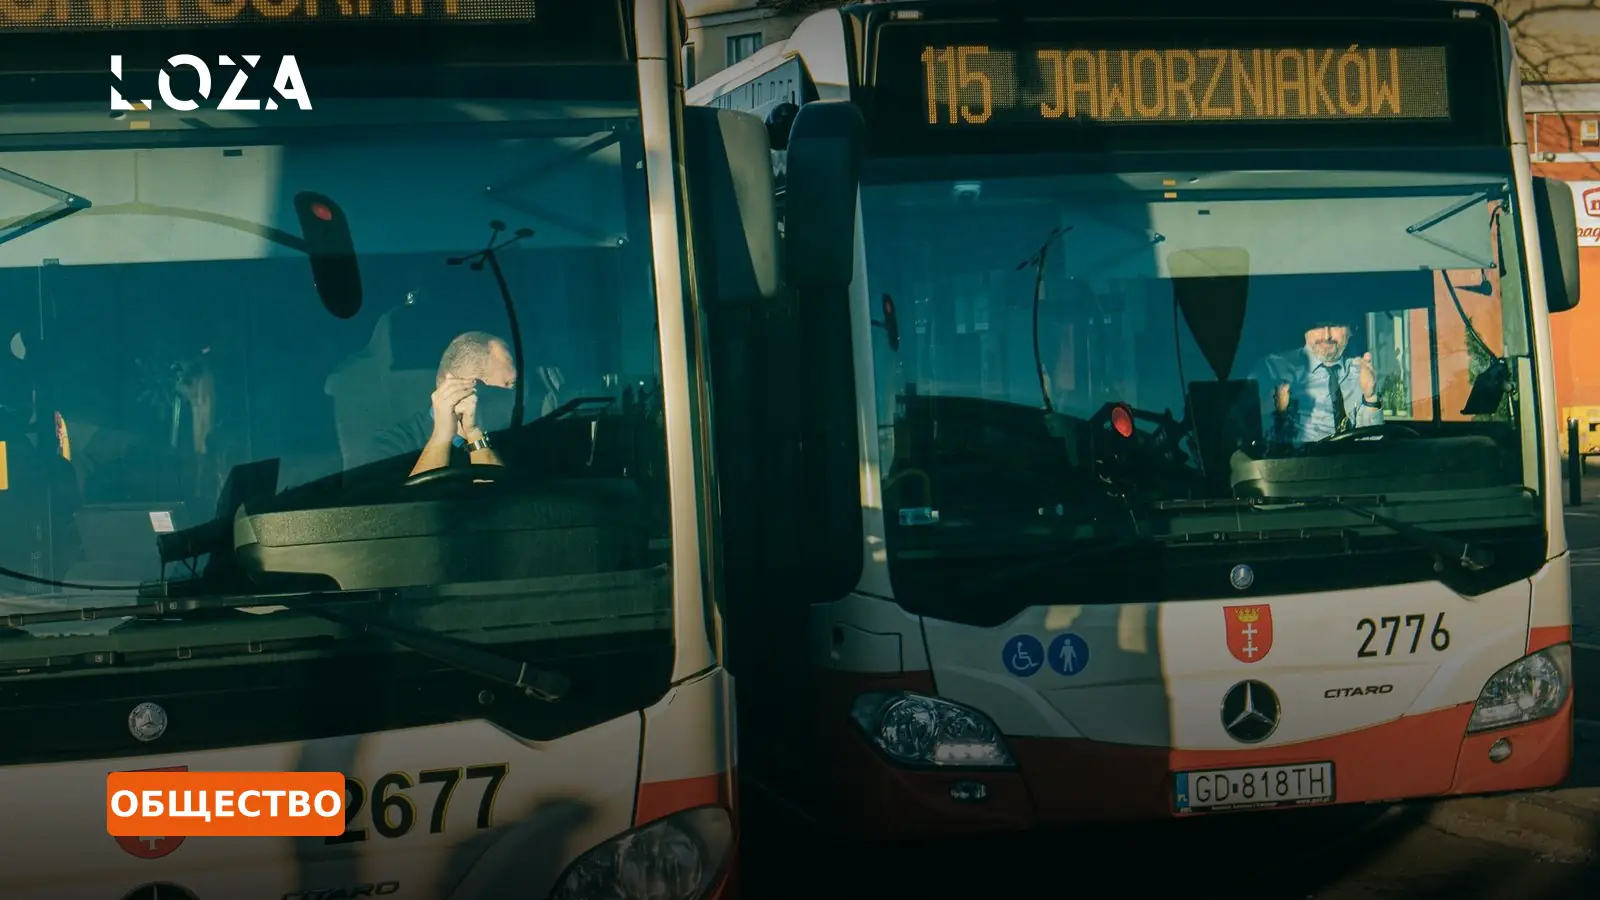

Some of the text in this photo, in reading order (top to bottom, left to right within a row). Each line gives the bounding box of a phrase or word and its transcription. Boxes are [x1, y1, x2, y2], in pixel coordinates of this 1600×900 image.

[921, 44, 1401, 124] 115 JAWORZNIAKÓW
[1356, 611, 1450, 658] 2776
[1324, 684, 1394, 699] CITARO
[325, 762, 510, 845] 2677
